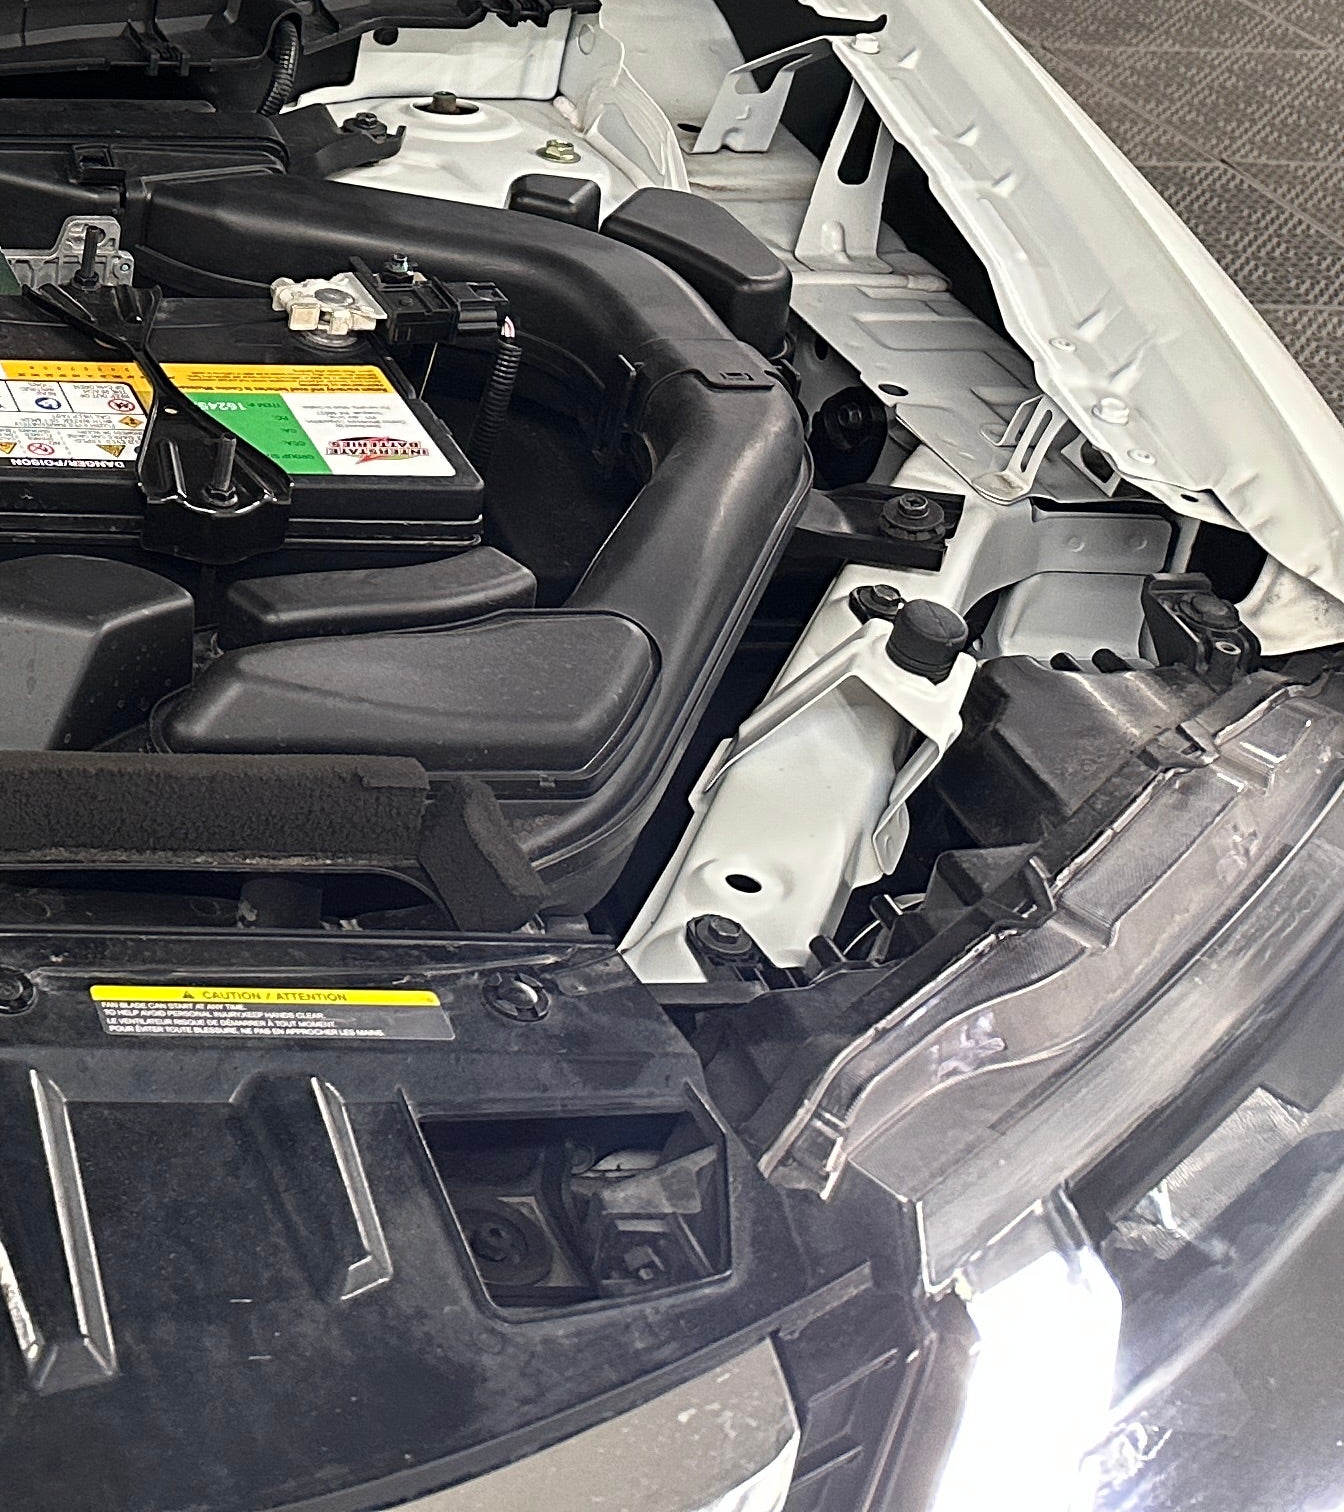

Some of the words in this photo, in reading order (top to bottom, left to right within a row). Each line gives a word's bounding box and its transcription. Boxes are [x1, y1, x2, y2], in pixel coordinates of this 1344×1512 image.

[329, 441, 423, 449] BATTERIES
[326, 447, 429, 456] INTERSTATE
[10, 459, 126, 469] DANGER/POISON
[202, 990, 262, 1000] CAUTION
[277, 992, 347, 1002] ATTENTION
[167, 1009, 213, 1017] PERSONAL
[117, 1017, 173, 1025] VENTILATEUR
[173, 1018, 206, 1026] RISQUE
[206, 1018, 219, 1026] DE
[275, 1019, 298, 1027] TOUT
[165, 1026, 193, 1034] TOUTE
[253, 1027, 272, 1035] PAS
[285, 1028, 339, 1036] APPROCHER
